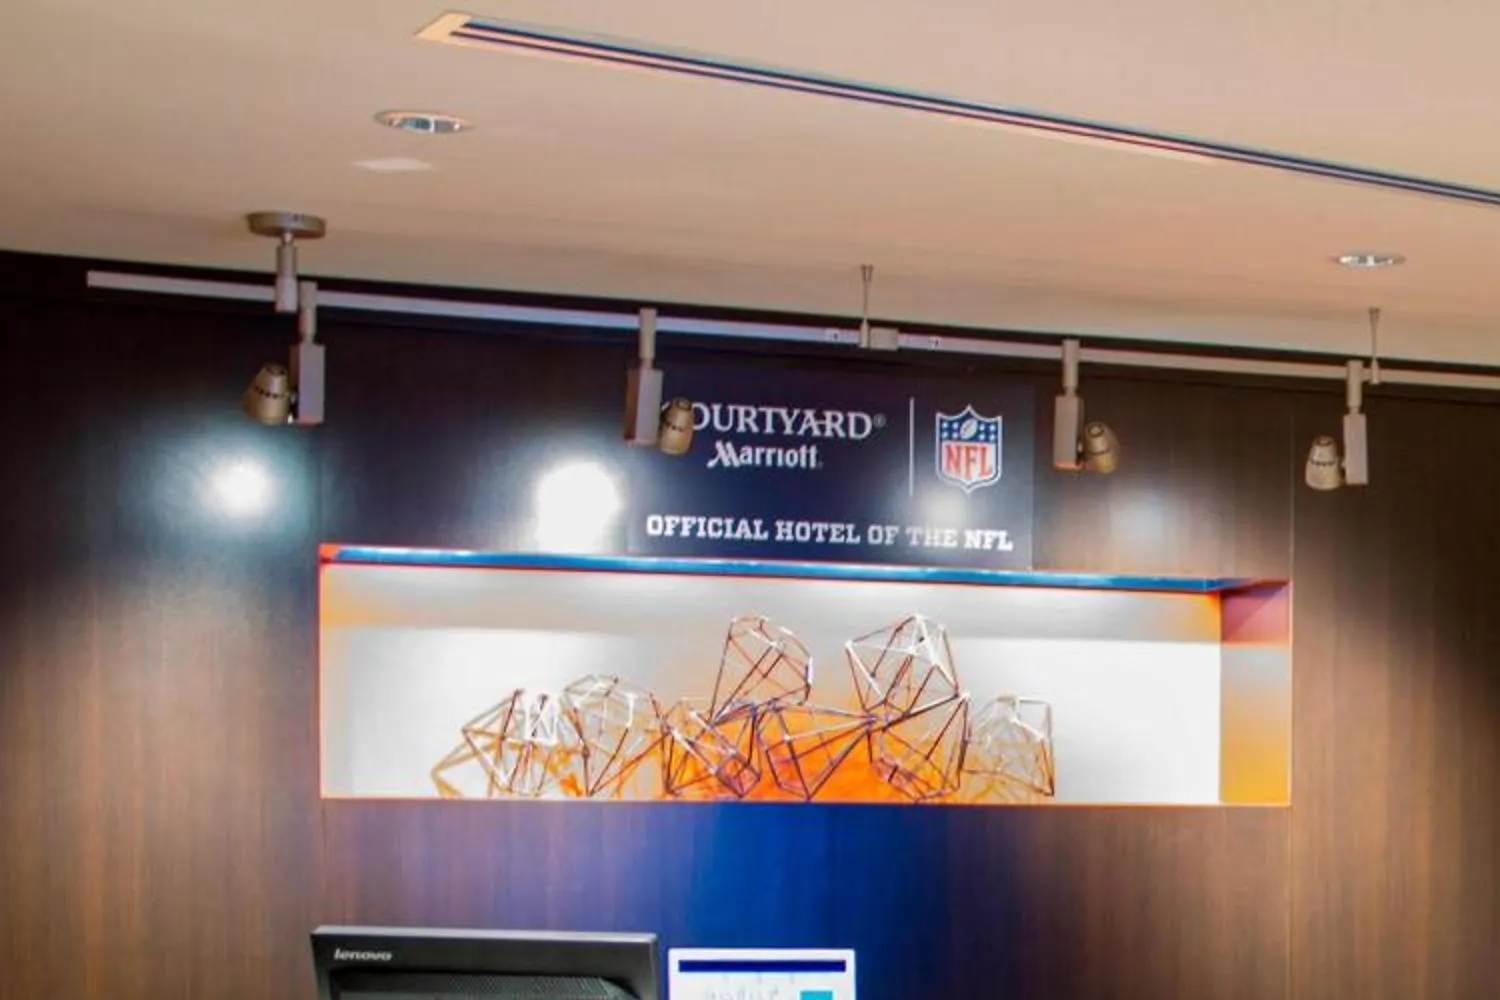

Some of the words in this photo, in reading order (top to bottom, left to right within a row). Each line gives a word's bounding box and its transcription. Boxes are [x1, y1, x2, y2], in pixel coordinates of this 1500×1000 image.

[661, 400, 873, 440] OURTYARD
[706, 440, 818, 468] Marriott
[945, 444, 993, 480] NFL
[646, 514, 769, 541] OFFICIAL
[774, 519, 861, 545] HOTEL
[867, 524, 899, 546] OF
[904, 526, 958, 548] THE
[964, 529, 1013, 551] NFL
[334, 948, 392, 961] lenovo
